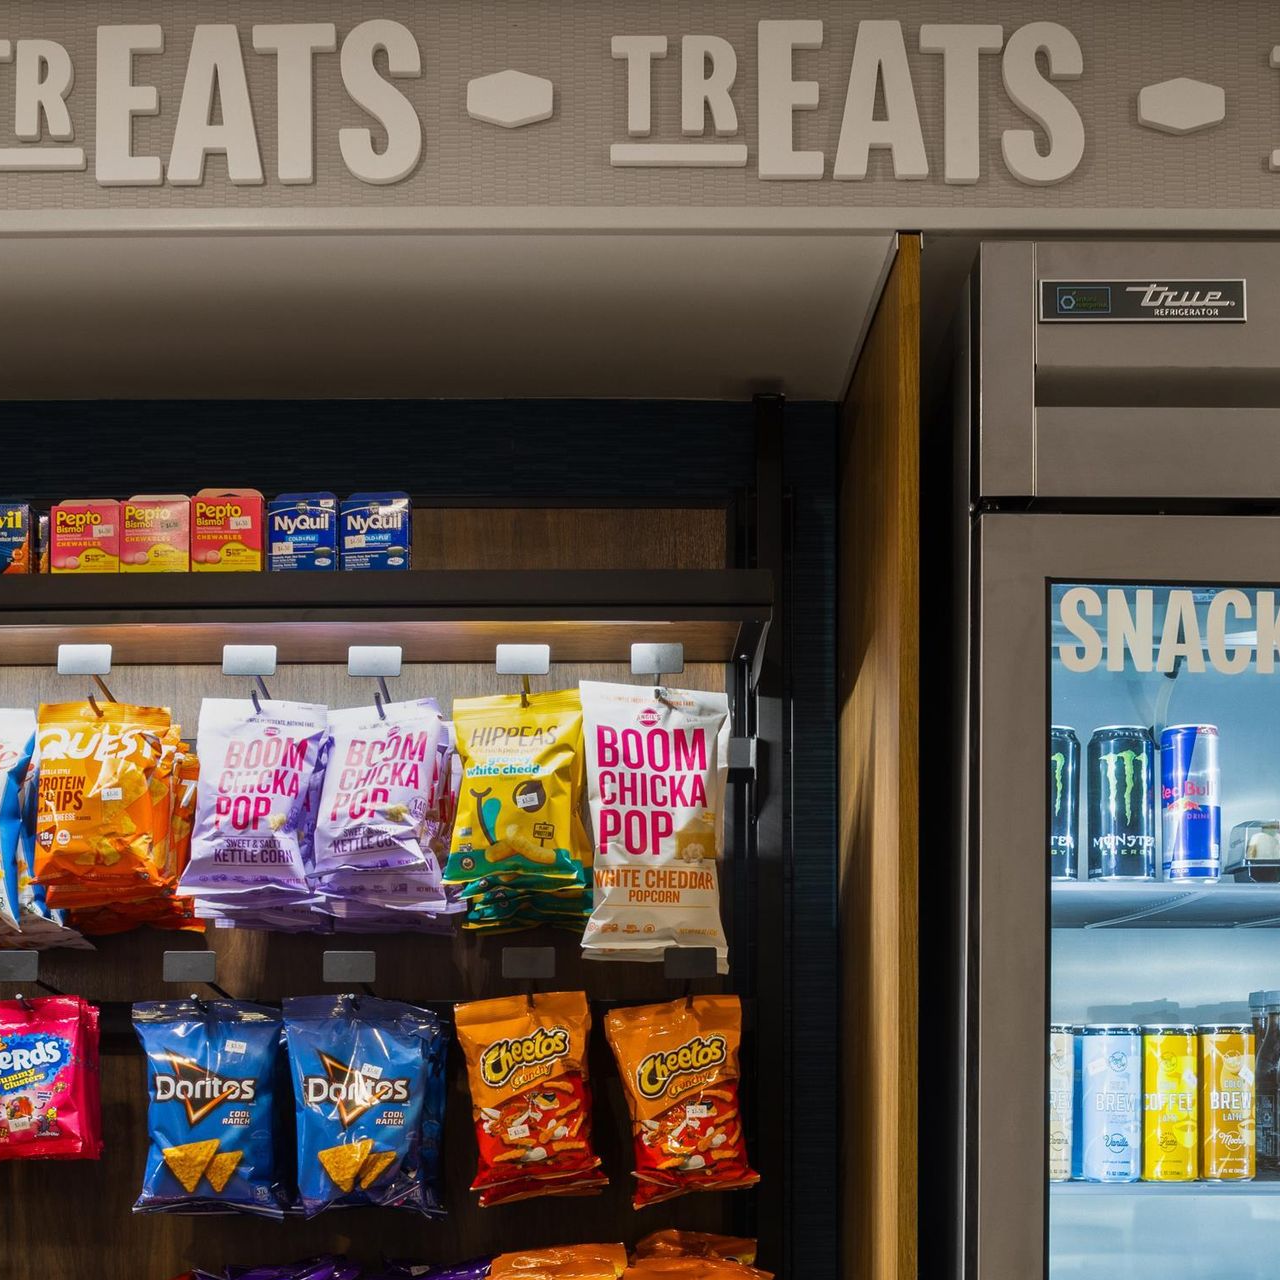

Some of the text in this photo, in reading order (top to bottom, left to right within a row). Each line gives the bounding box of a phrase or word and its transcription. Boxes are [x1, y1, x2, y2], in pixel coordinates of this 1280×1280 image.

[609, 19, 1087, 186] TREATS
[1126, 284, 1230, 307] true
[1154, 308, 1219, 316] REFRIGERATOR
[56, 511, 101, 526] Pepto
[125, 506, 170, 521] Pepto
[196, 503, 241, 518] Pepto
[56, 525, 85, 534] Bismol
[125, 520, 153, 529] Bismol
[196, 518, 224, 527] Bismol
[274, 514, 329, 534] NyQuil
[347, 513, 401, 534] NyQuil
[471, 725, 558, 747] HIPPEAS
[223, 737, 309, 771] BOOM
[596, 724, 708, 772] BOOM
[38, 776, 86, 792] PROTEIN
[599, 771, 708, 808] CHICKA
[215, 795, 272, 830] POP
[600, 809, 673, 855] POP
[214, 849, 294, 864] KETTLE CORN
[594, 869, 714, 890] WHITE CHEDDAR
[629, 890, 680, 903] POPCORN
[484, 1030, 568, 1082] Cheetos
[641, 1036, 726, 1095] Cheetos
[156, 1076, 255, 1100] Doritos
[308, 1076, 408, 1102] Doritos
[1210, 1091, 1251, 1110] BREW
[222, 1117, 251, 1126] RANCH
[229, 1110, 251, 1118] COOL
[375, 1117, 404, 1126] RANCH
[382, 1110, 404, 1118] COOL
